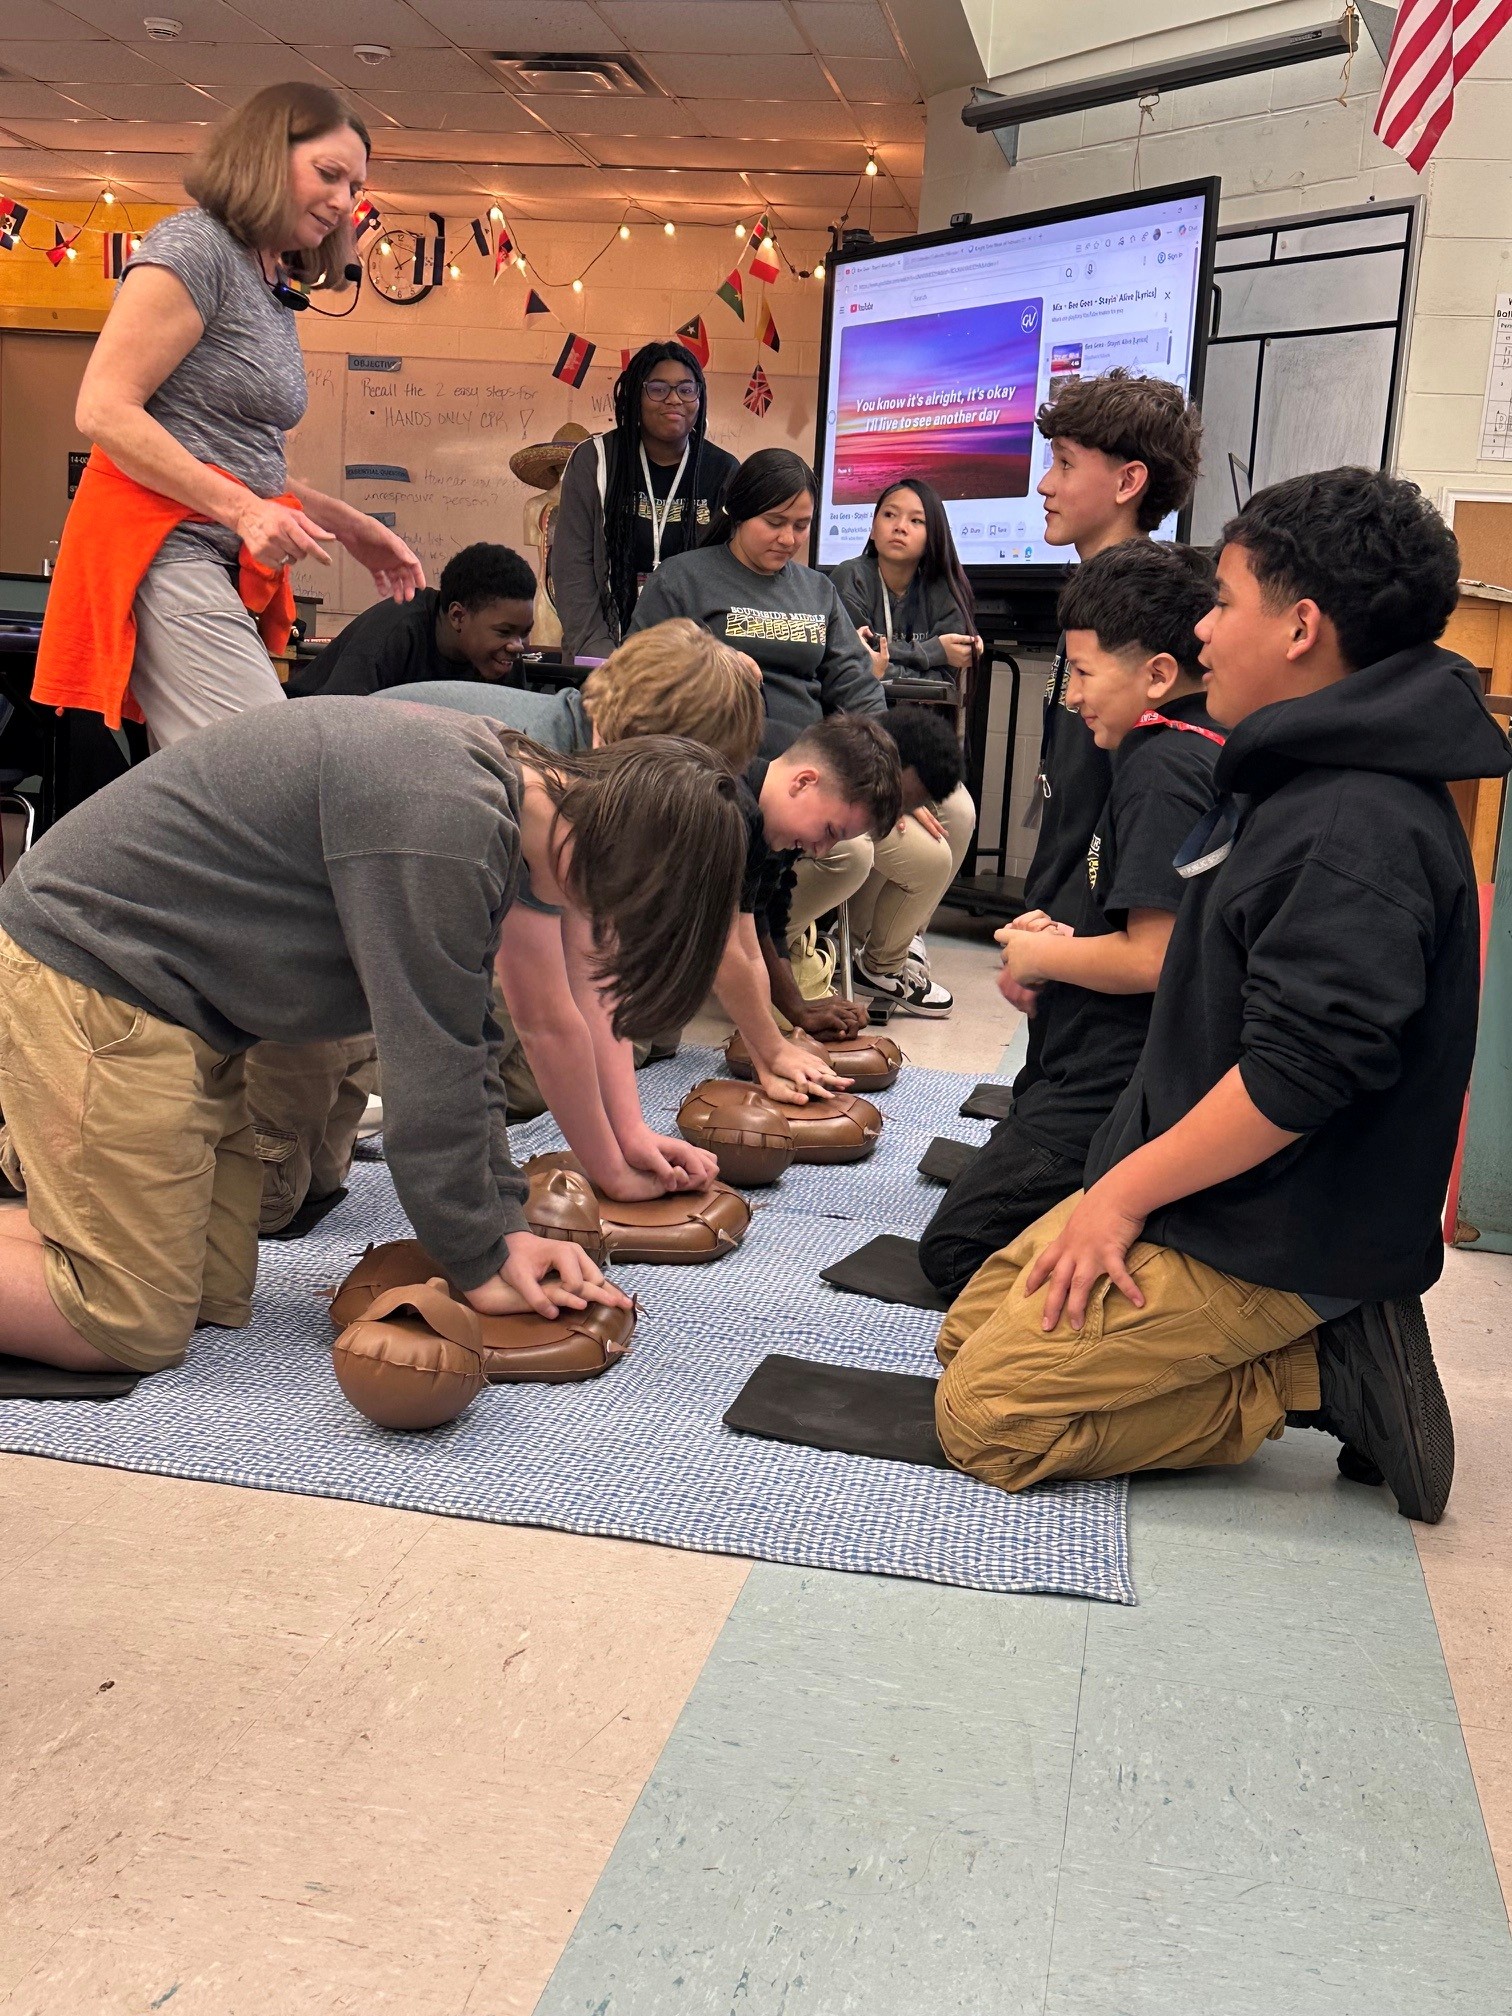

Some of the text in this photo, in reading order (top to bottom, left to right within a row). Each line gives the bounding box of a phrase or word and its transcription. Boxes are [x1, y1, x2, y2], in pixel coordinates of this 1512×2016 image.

[353, 359, 397, 368] OBJECTIV
[362, 377, 538, 407] Recall the 2 easy steps for
[856, 385, 1016, 413] You know it's alright, it's okay
[385, 406, 432, 428] HANDS
[438, 411, 473, 434] ONLY
[480, 409, 508, 432] CPR
[866, 407, 1000, 432] I'll live to see another day
[730, 606, 826, 623] SOUTHSIDE MIDDLE
[725, 612, 826, 646] KNIGHTS
